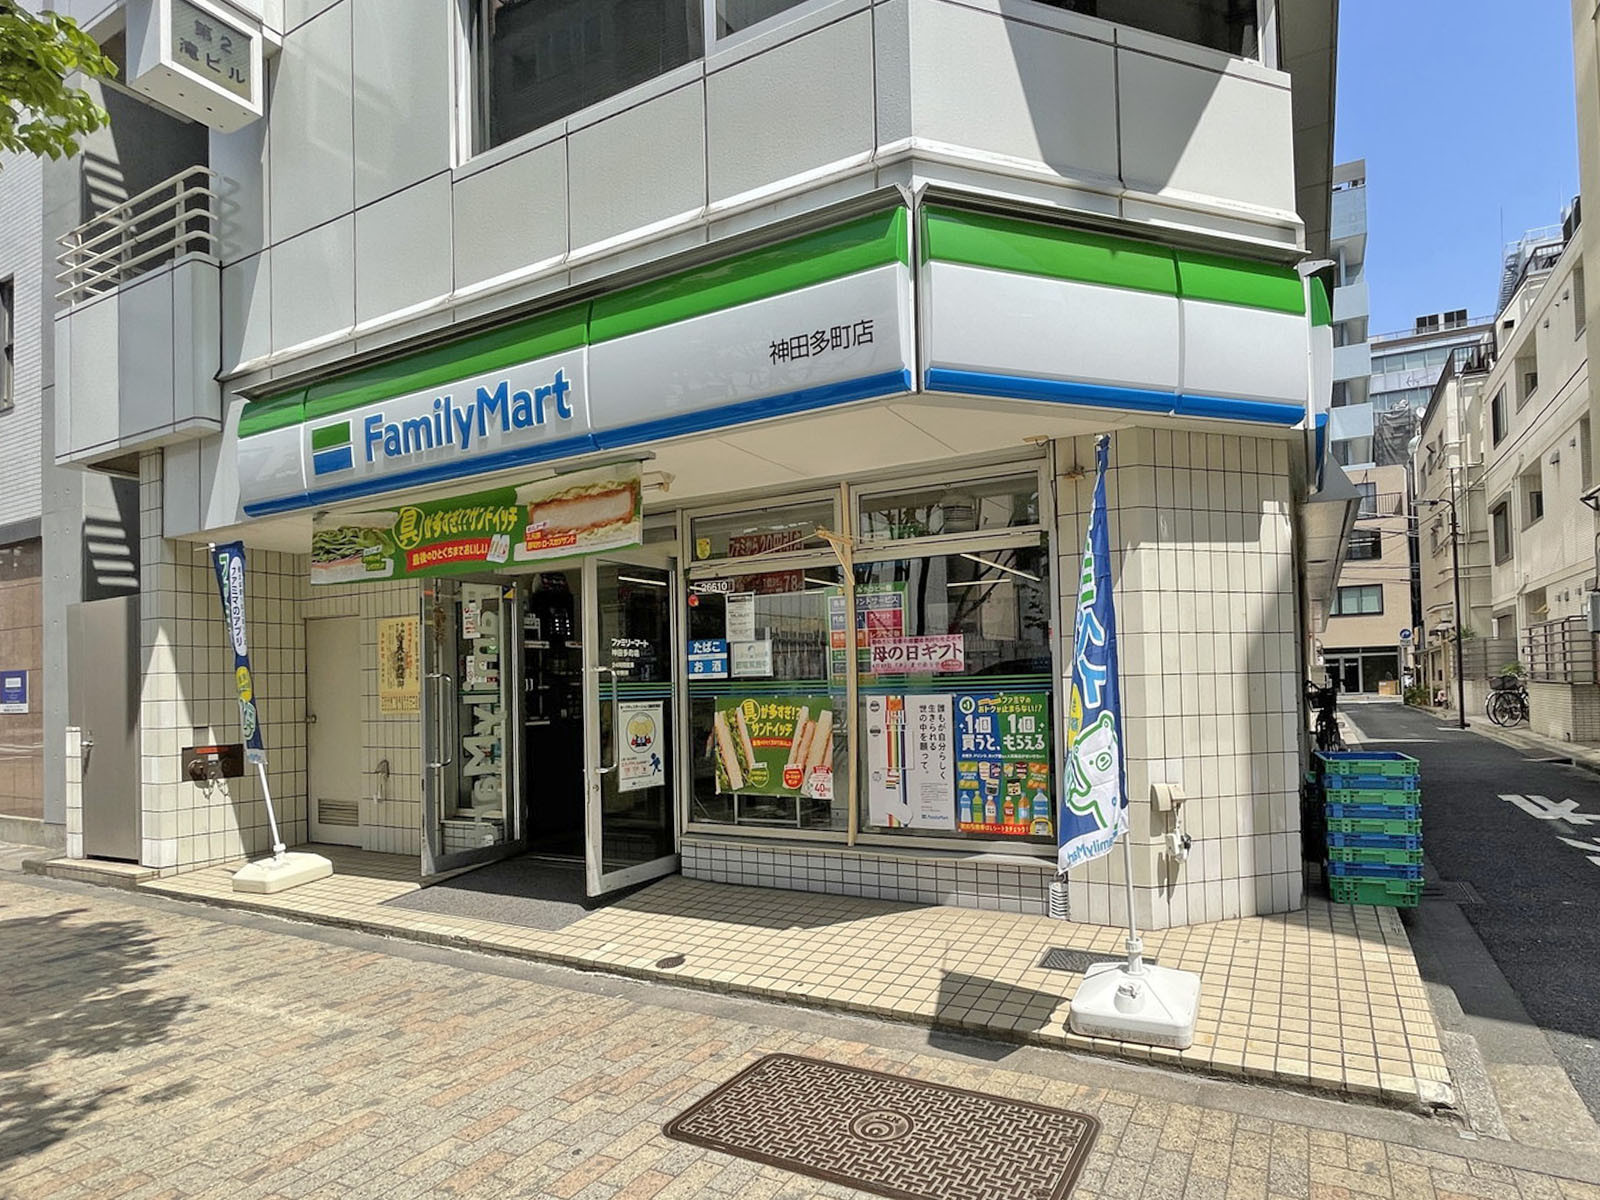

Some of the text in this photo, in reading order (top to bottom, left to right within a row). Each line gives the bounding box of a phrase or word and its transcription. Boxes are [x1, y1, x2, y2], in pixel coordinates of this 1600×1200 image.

[768, 319, 875, 365] 神田多町店
[363, 366, 573, 463] FamilyMart
[411, 542, 489, 566] 最後のひとくちまでおいしい
[611, 638, 650, 649] ファミリーマート
[693, 641, 721, 654] たばこ
[872, 642, 963, 663] 母の日ギフト
[694, 660, 722, 673] お酒
[751, 722, 793, 737] サンドイッチ
[928, 704, 937, 751] 生きられる
[965, 713, 1035, 734] 1個 1個
[937, 704, 947, 780] 誰もが自分らしく
[962, 734, 1045, 751] 買うと、 もらえる
